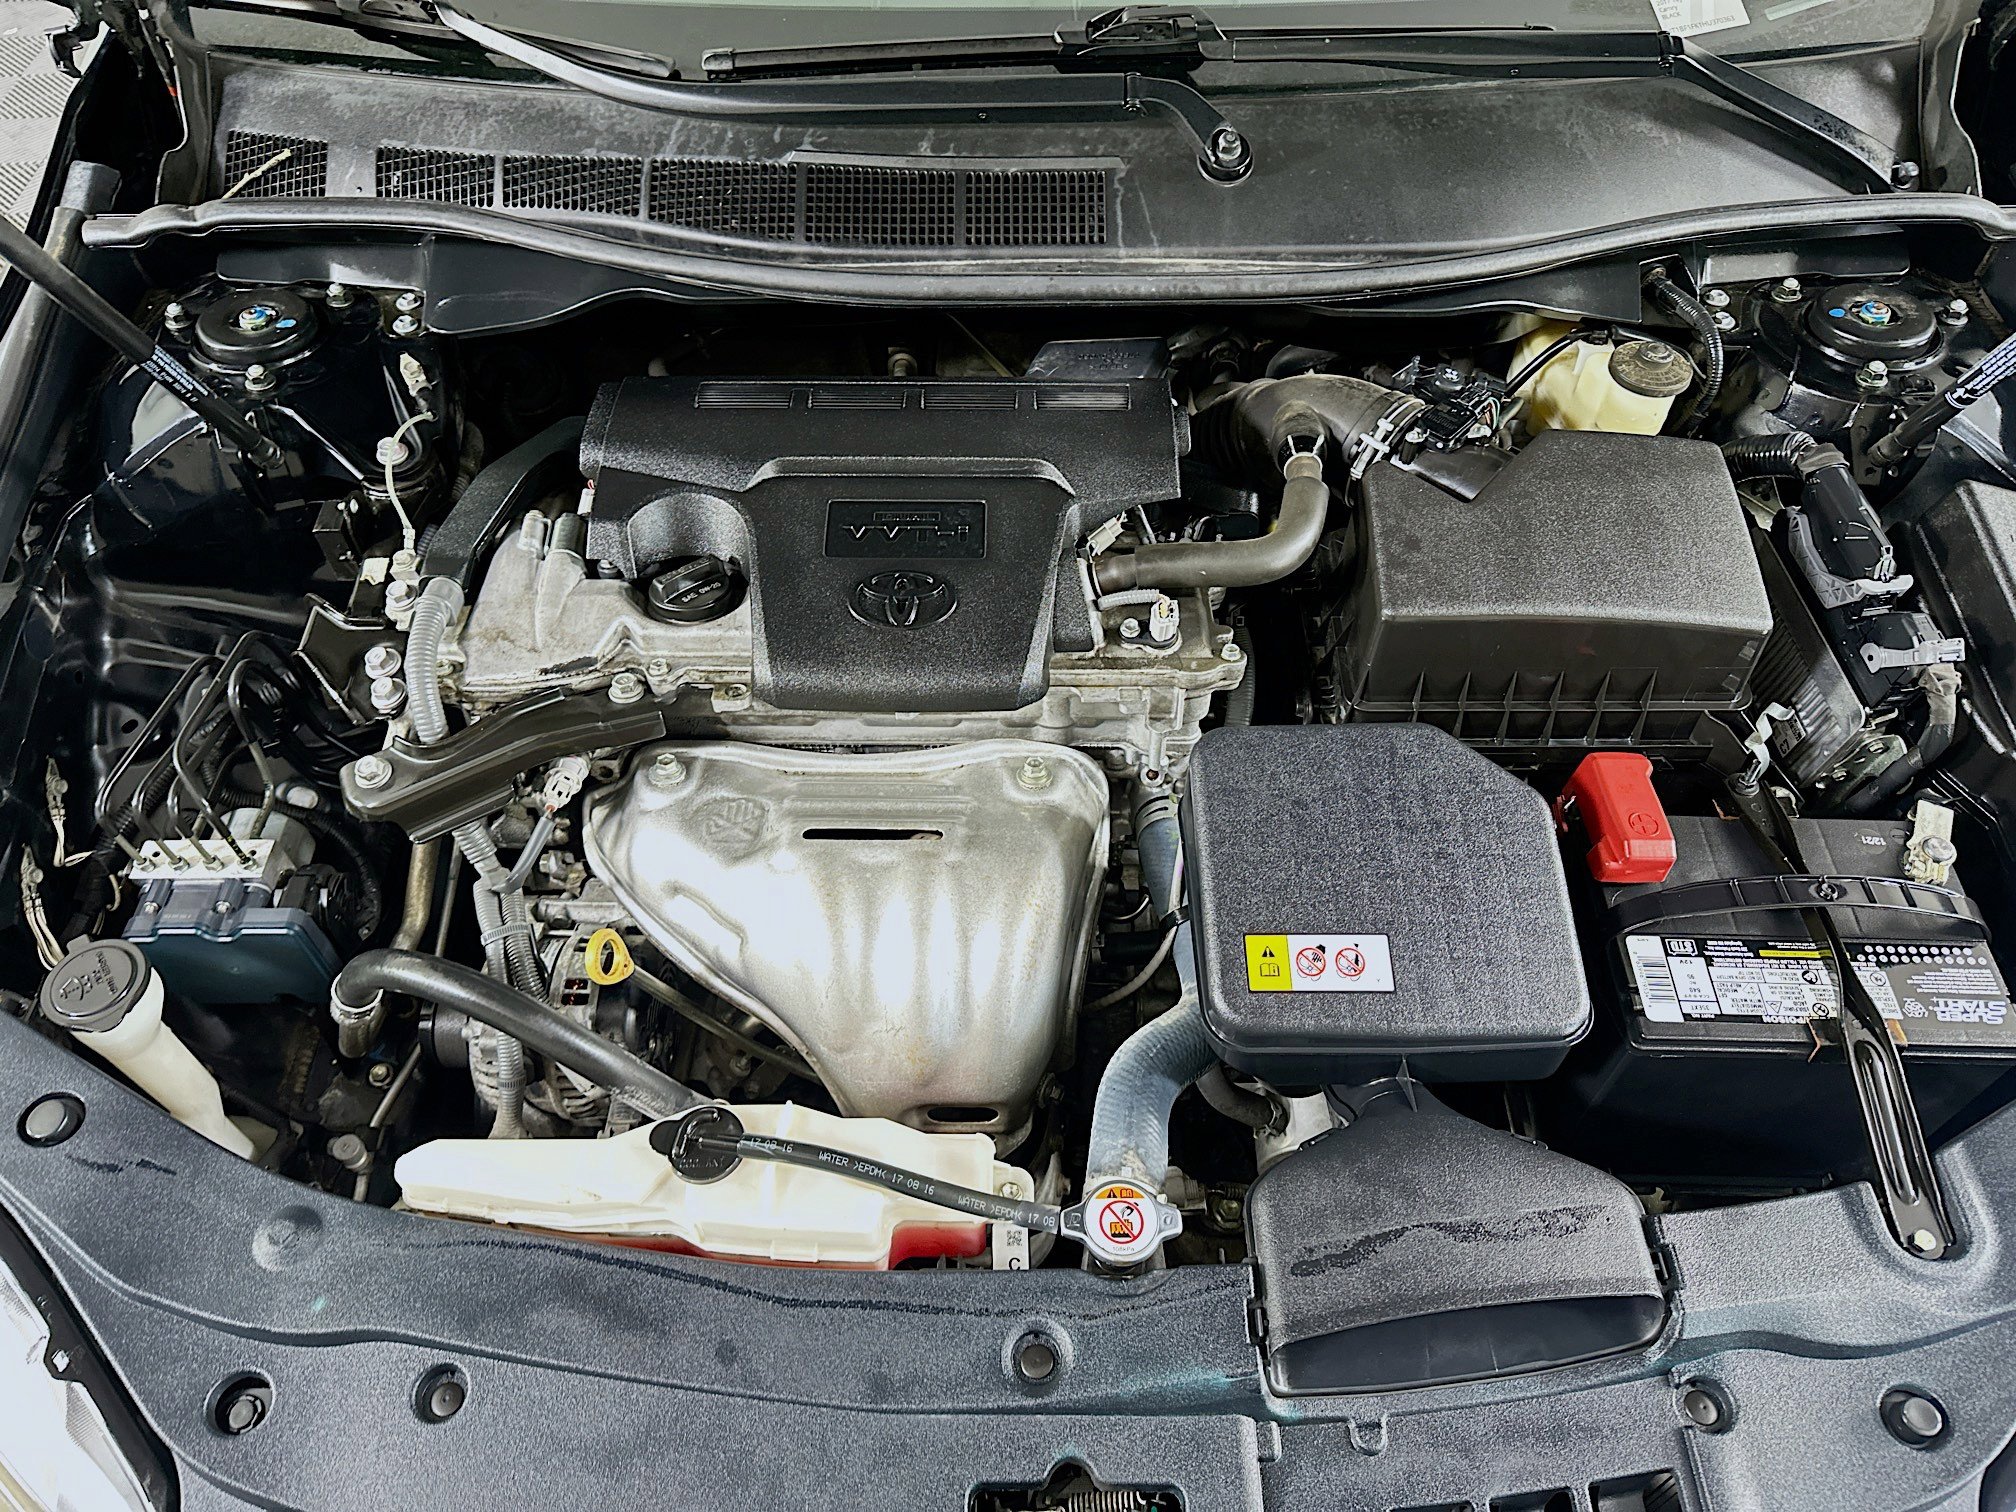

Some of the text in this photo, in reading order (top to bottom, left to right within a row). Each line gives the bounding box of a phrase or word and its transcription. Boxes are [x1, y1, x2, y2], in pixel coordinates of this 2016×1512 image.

[681, 582, 721, 603] SAE 0W-20
[1935, 1001, 2007, 1014] START
[1937, 1011, 2004, 1024] SUPER
[750, 1138, 793, 1153] 17 08 16
[818, 1151, 849, 1167] WATER
[891, 1173, 903, 1183] 17
[907, 1178, 920, 1190] 08
[923, 1183, 935, 1196] 16
[957, 1195, 986, 1211] WATER
[1028, 1212, 1039, 1224] 17
[1043, 1216, 1055, 1227] 08
[1008, 1257, 1021, 1271] C
